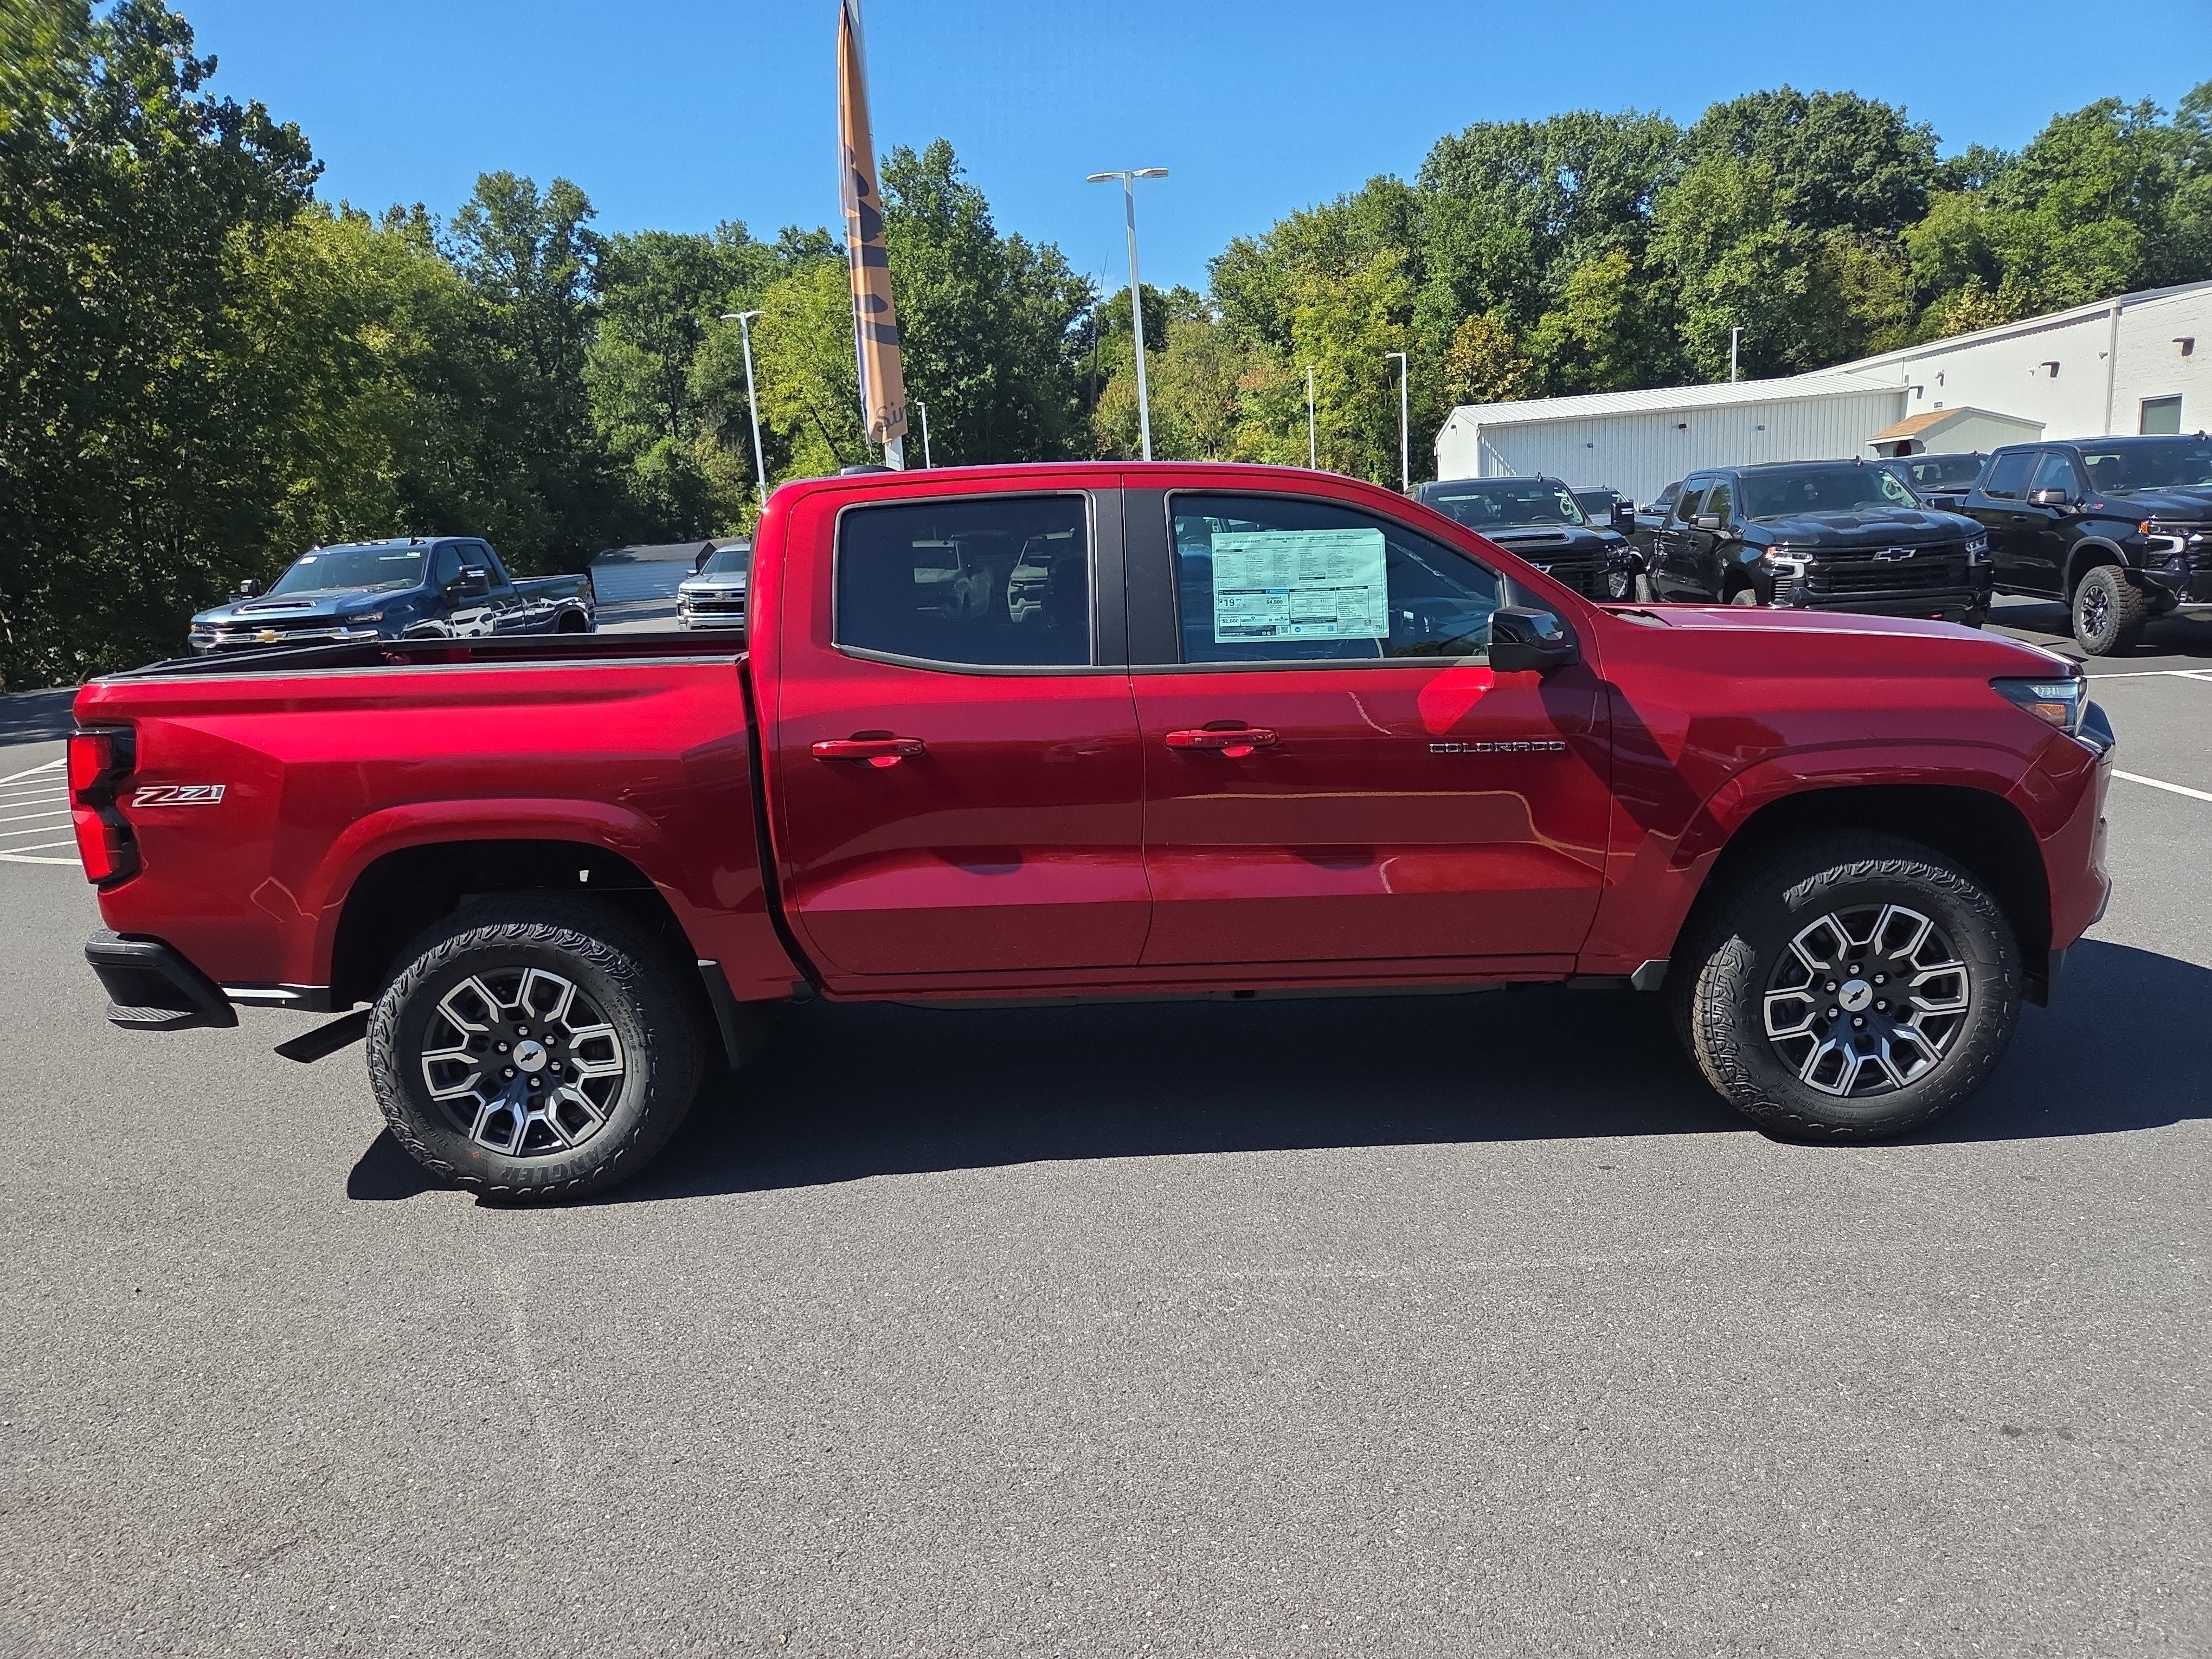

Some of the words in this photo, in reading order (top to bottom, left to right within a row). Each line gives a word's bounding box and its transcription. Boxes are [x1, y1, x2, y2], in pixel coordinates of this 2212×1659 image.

[1224, 599, 1234, 607] 19
[1430, 741, 1565, 753] COLORADO
[132, 785, 226, 807] Z71
[500, 1120, 632, 1184] WRANGLER
